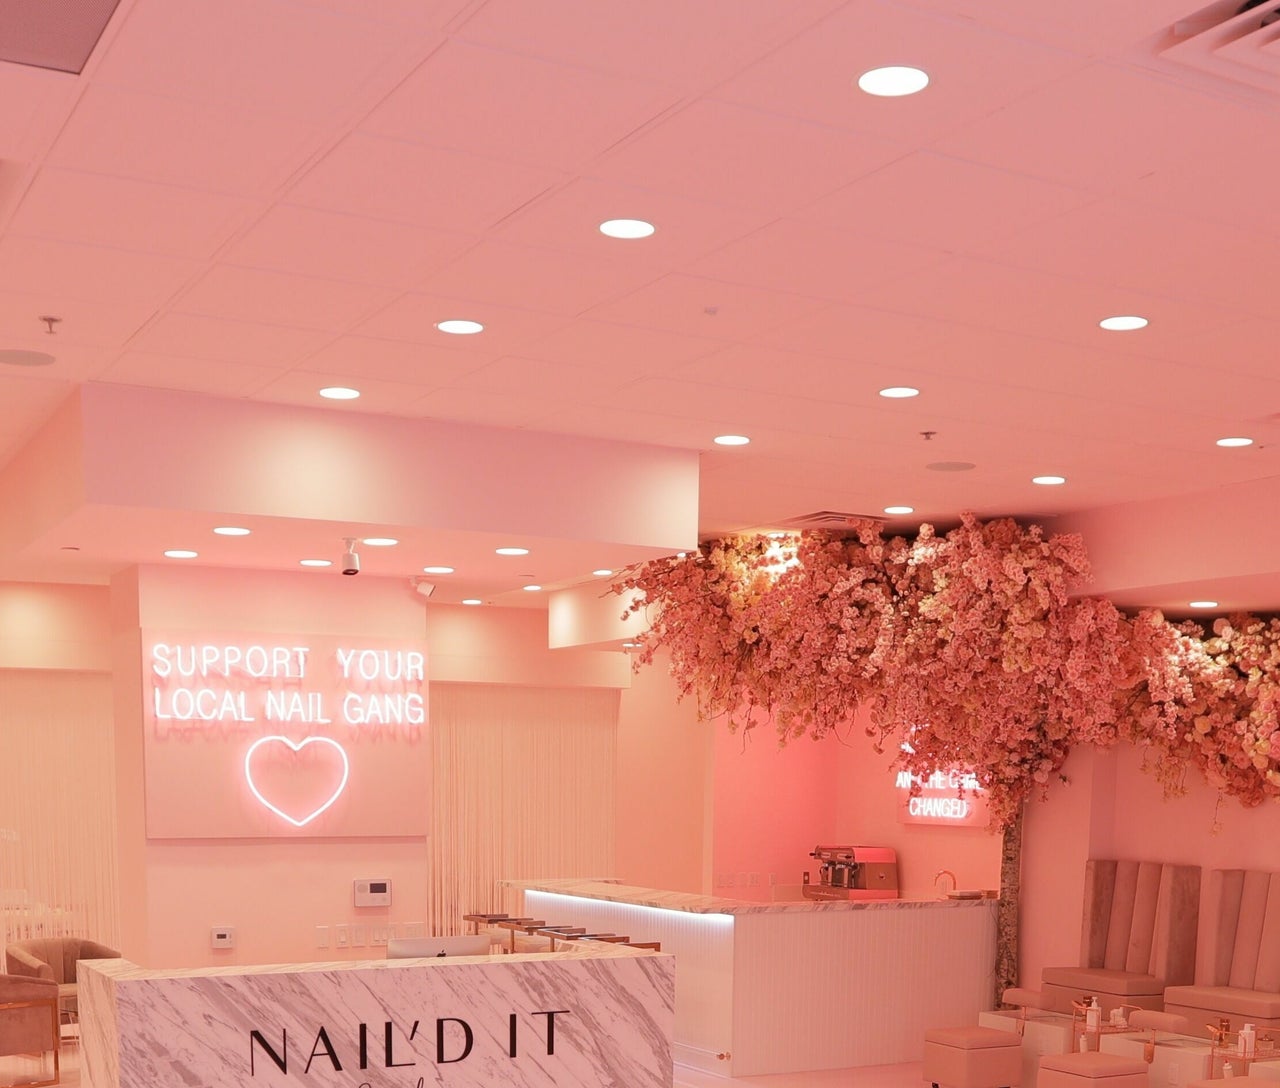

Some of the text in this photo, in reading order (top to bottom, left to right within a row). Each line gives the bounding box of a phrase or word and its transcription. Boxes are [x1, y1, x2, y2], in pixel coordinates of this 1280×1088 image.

[151, 643, 425, 681] SUPPORT YOUR
[154, 688, 425, 725] LOCAL NAIL GANG
[909, 797, 967, 819] CHANGED
[249, 1010, 571, 1077] NAIL'D IT
